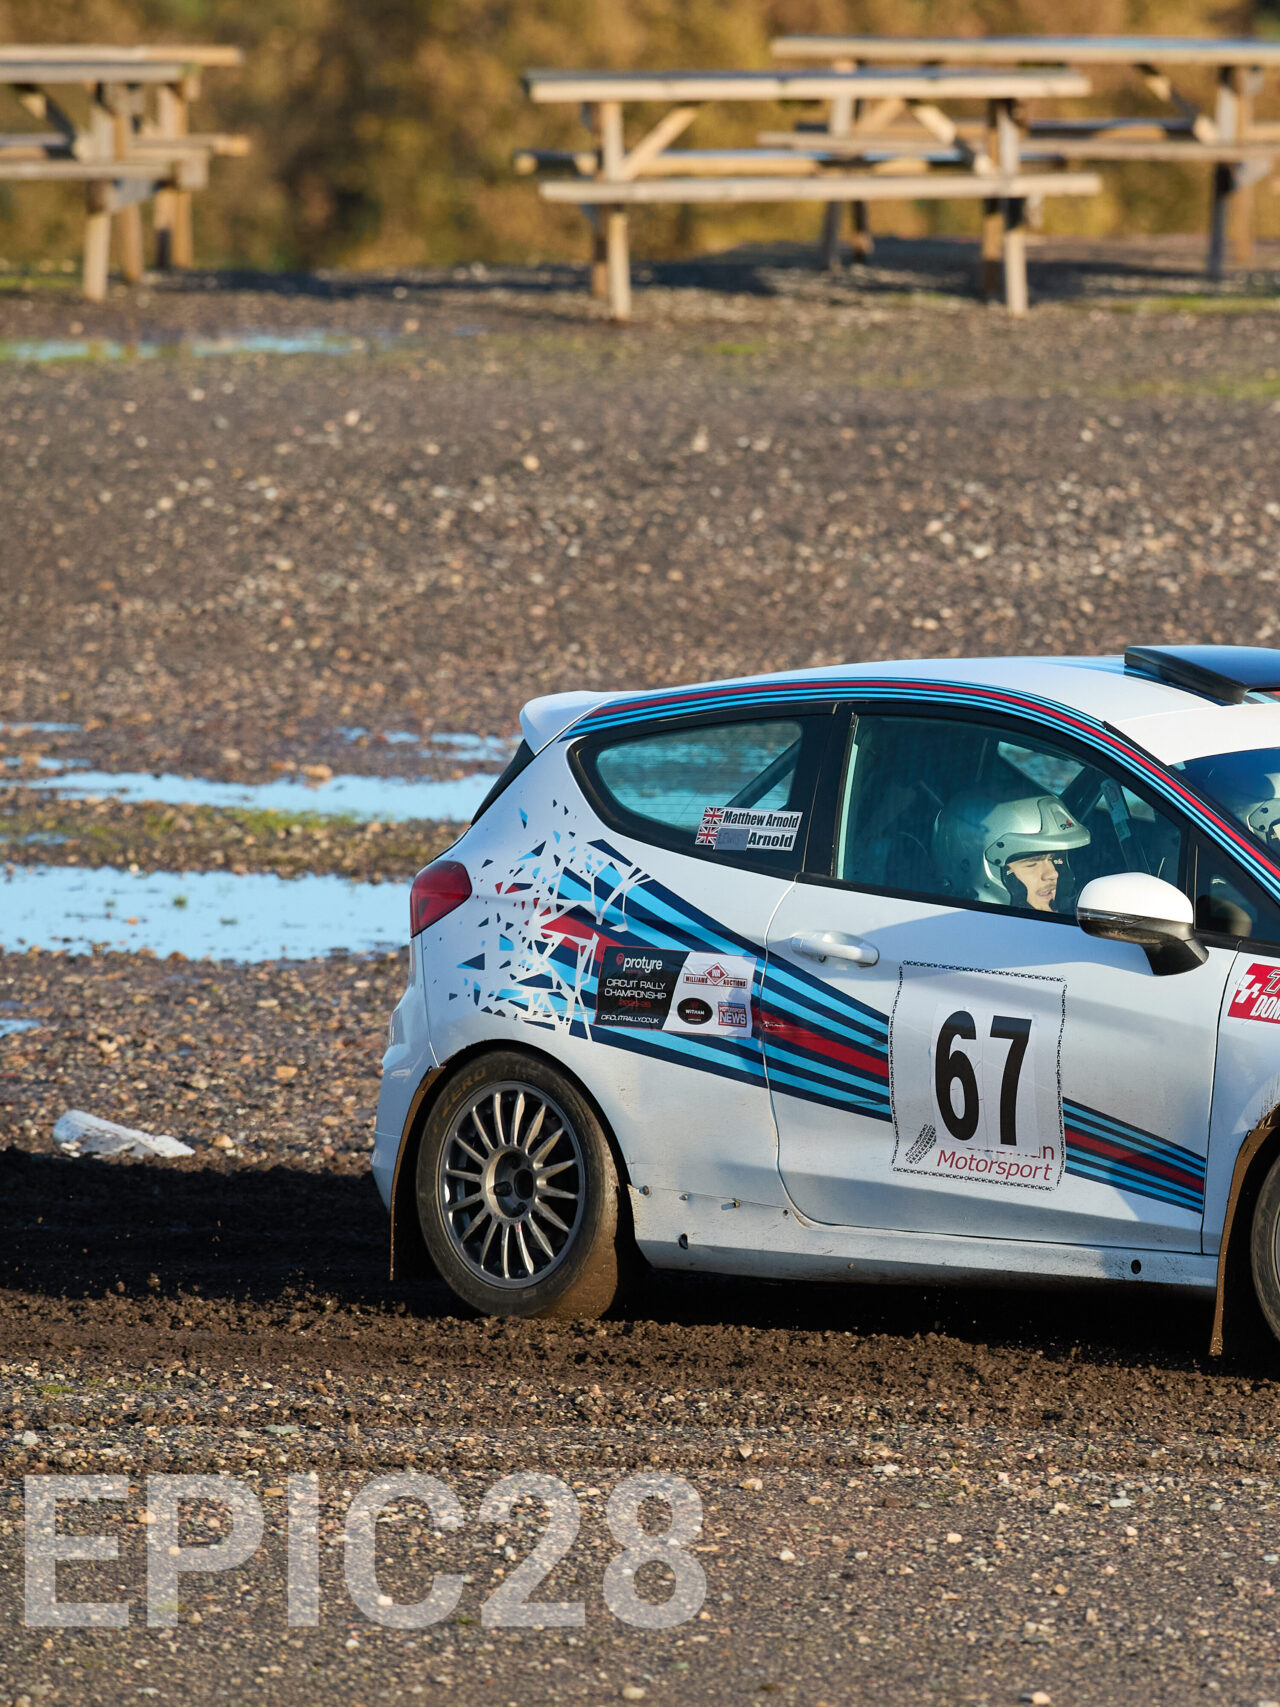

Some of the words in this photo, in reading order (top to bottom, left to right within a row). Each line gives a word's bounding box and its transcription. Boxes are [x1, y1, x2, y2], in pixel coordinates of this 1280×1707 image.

[723, 811, 766, 826] Matthew
[766, 814, 799, 828] Arnold
[748, 832, 793, 847] Arnold
[622, 956, 663, 973] protyre
[606, 978, 638, 988] CIRCUIT
[640, 980, 666, 990] RALLY
[685, 976, 708, 984] WILLIAMS
[723, 979, 746, 987] AUCTIONS
[604, 988, 667, 1000] CHAMPIONSHIP
[720, 1012, 746, 1025] NEWS
[935, 1010, 1033, 1147] 67
[936, 1150, 1053, 1181] Motorsport
